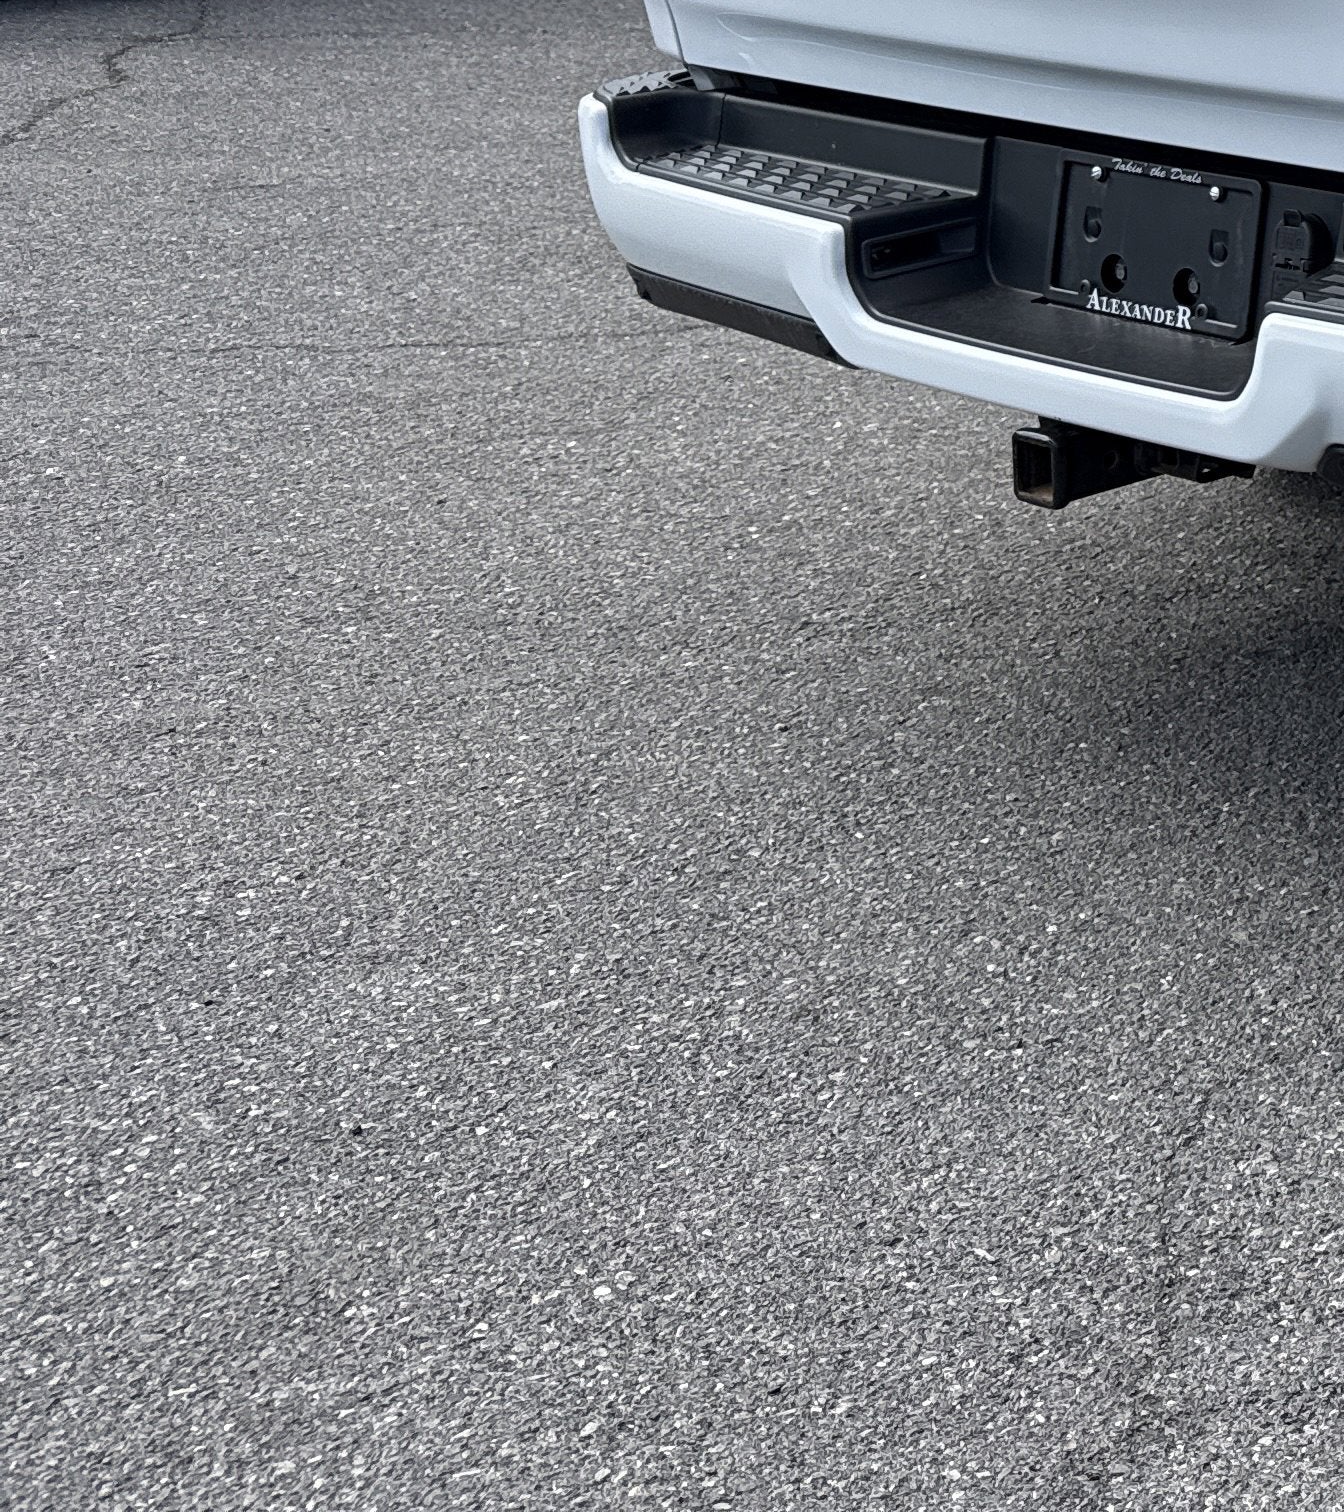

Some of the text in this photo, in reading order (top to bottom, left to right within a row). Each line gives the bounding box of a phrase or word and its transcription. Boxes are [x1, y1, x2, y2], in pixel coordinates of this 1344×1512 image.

[1150, 166, 1167, 178] the
[1170, 167, 1203, 184] Deals
[1086, 288, 1192, 330] ALEXANDER
